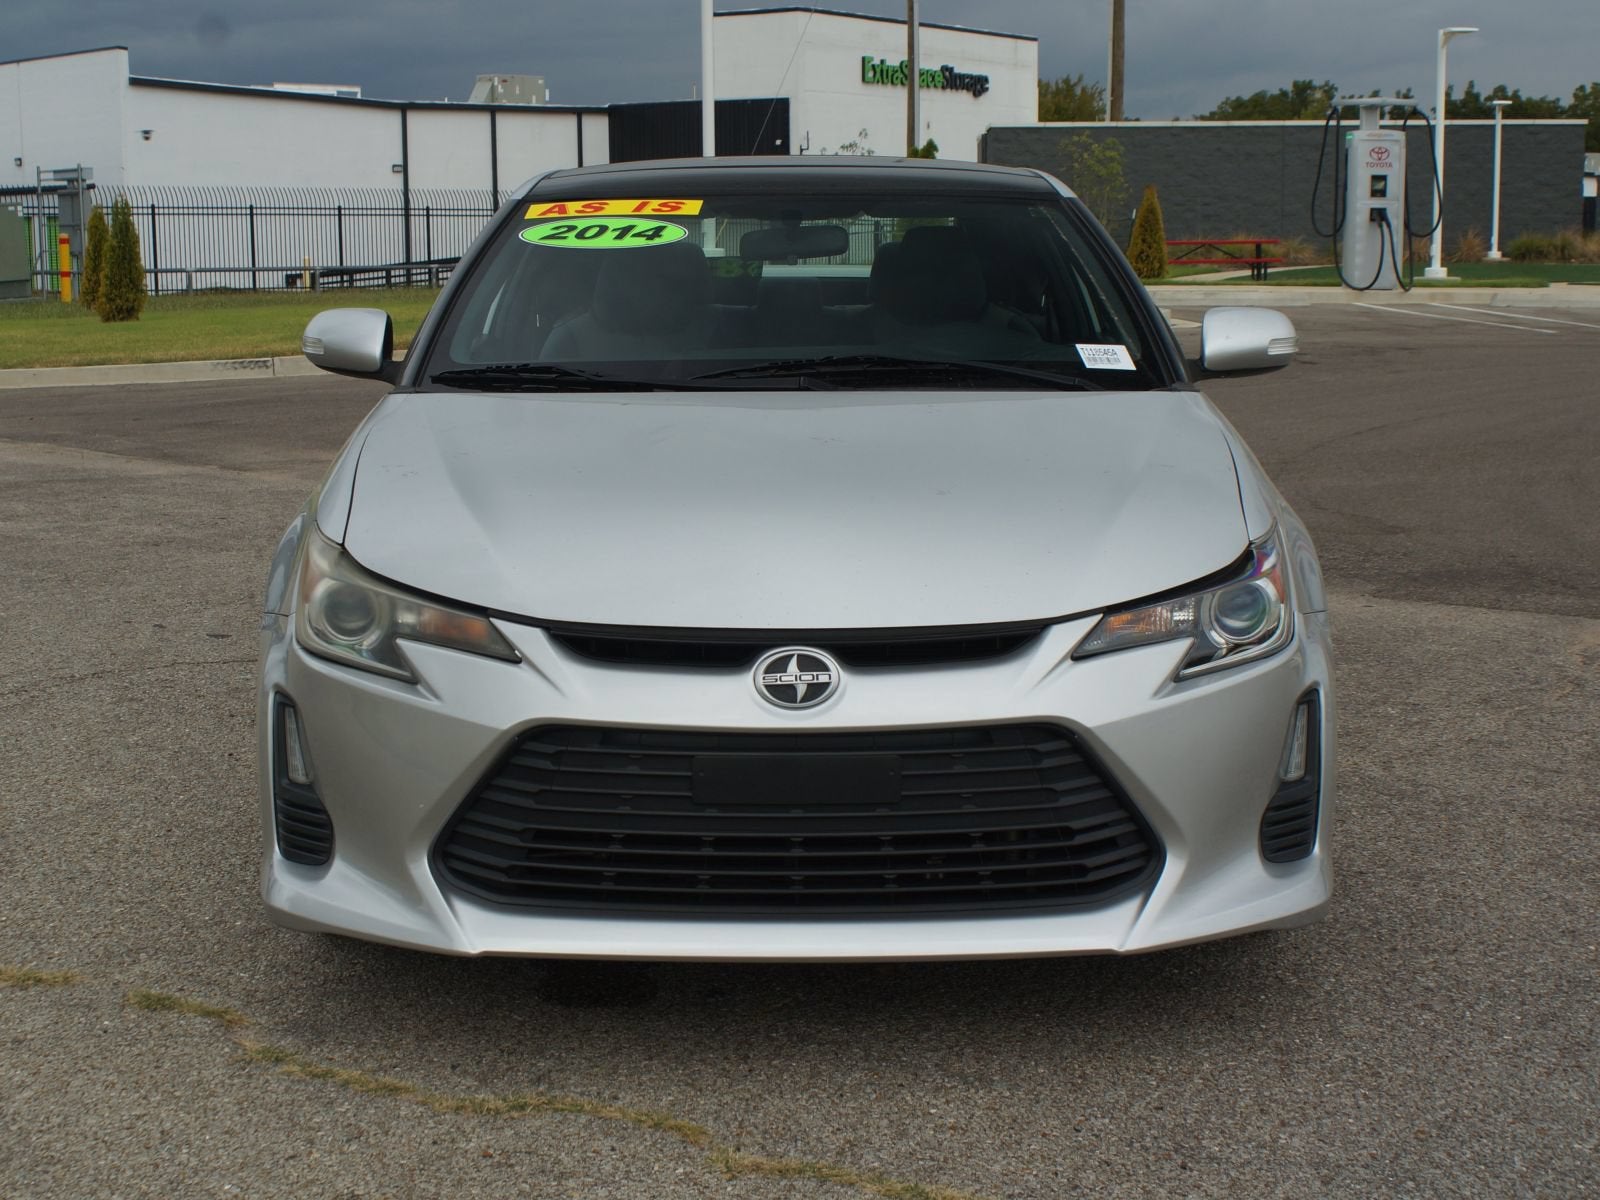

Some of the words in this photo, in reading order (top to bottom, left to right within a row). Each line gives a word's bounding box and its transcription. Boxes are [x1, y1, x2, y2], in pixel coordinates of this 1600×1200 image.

[1365, 161, 1393, 169] TOYOTA
[536, 202, 609, 217] AS
[631, 201, 686, 214] IS
[538, 224, 668, 242] 2014
[762, 673, 832, 684] SCION
